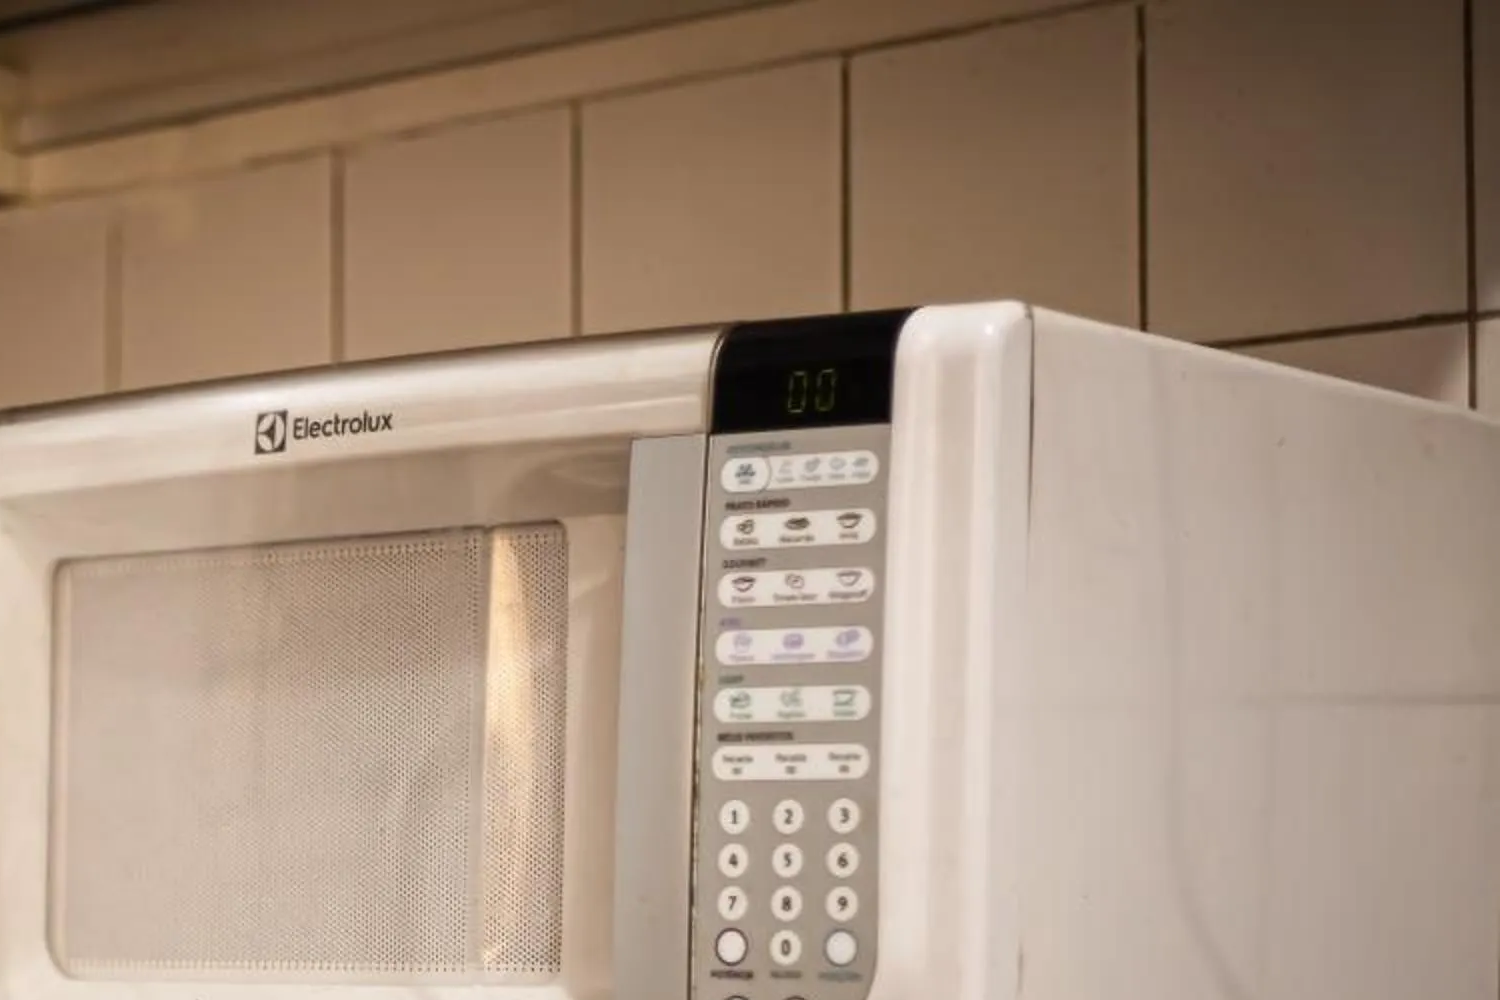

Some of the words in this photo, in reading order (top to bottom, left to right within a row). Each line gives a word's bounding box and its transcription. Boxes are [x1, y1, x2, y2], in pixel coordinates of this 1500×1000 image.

[292, 409, 394, 440] Electrolux
[731, 809, 738, 825] 1
[784, 808, 793, 825] 2
[840, 807, 850, 823] 3
[728, 853, 739, 867] 4
[783, 852, 792, 867] 5
[837, 852, 849, 869] 6
[728, 896, 737, 910] 7
[782, 896, 792, 912] 8
[837, 896, 848, 911] 9
[781, 939, 791, 956] 0
